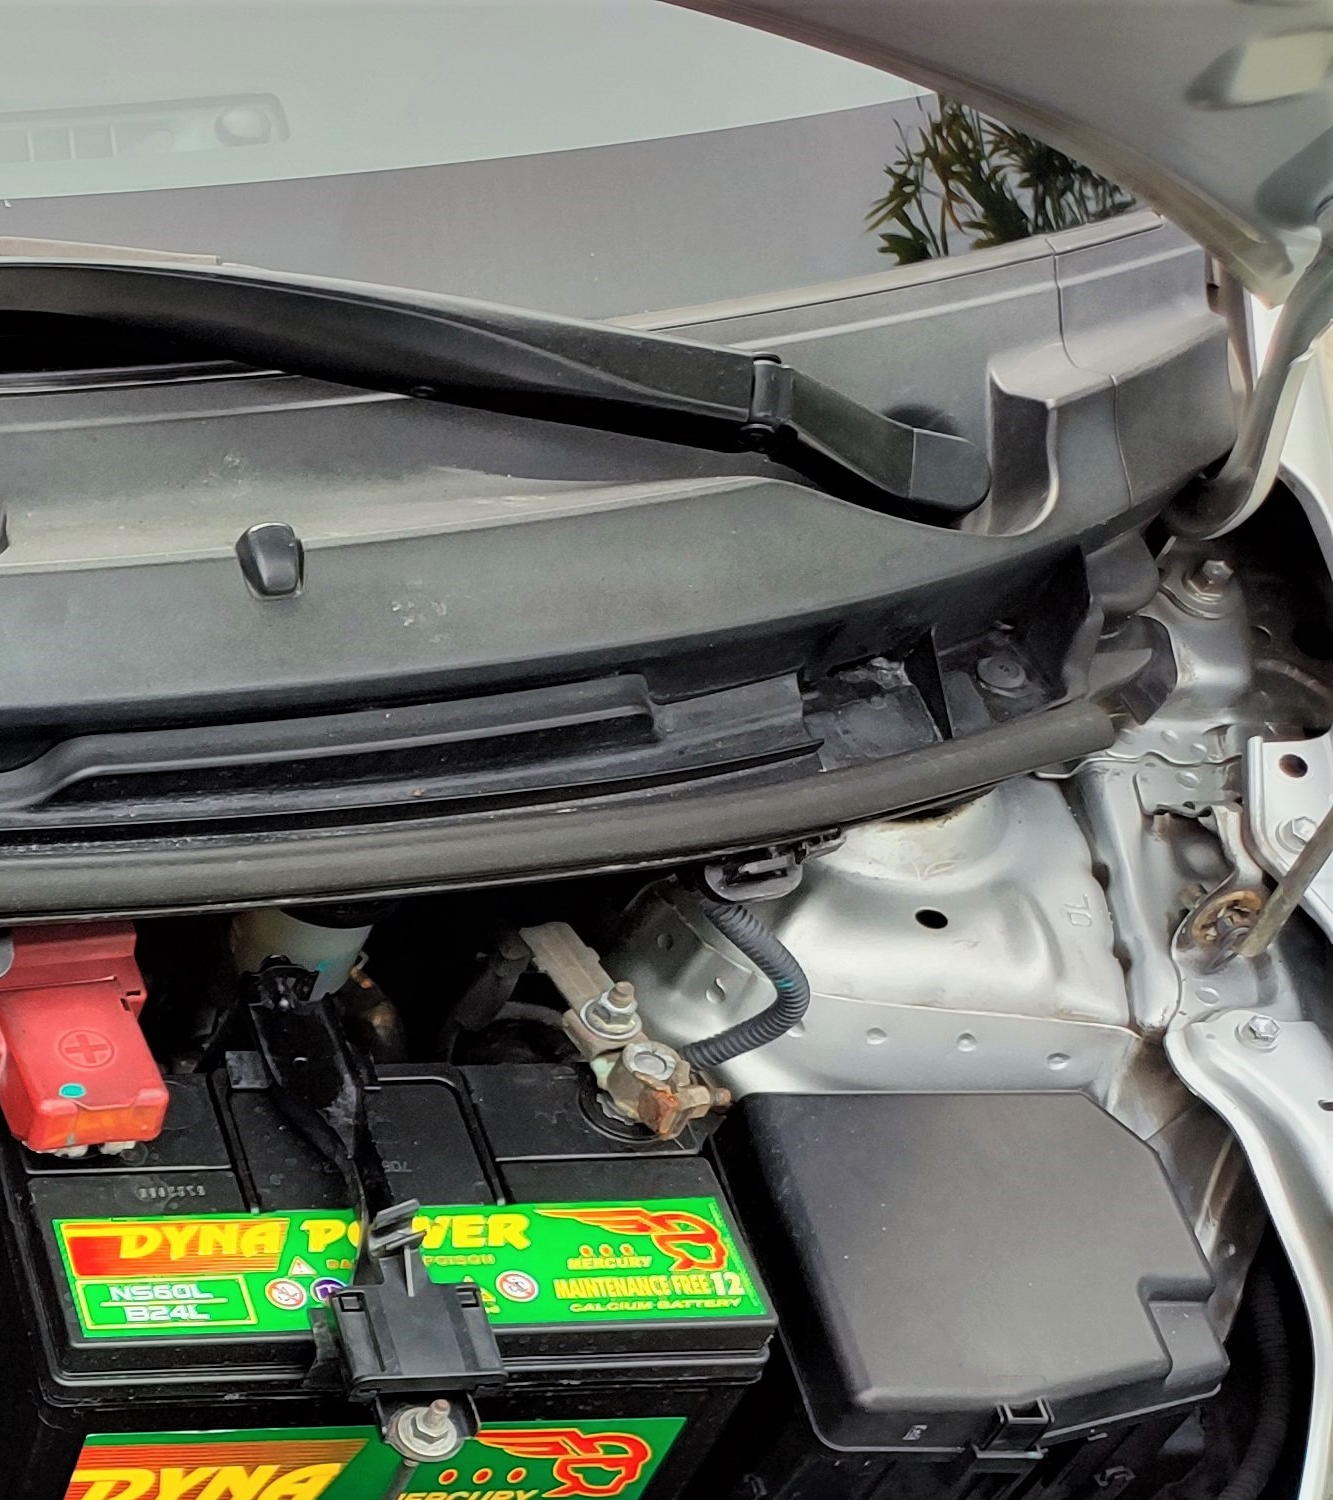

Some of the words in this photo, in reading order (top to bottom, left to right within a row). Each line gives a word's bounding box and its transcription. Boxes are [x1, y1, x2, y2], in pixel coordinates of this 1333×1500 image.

[113, 1222, 282, 1260] DYNA
[300, 1213, 532, 1253] PWER
[567, 1255, 653, 1270] MERCURY
[553, 1275, 669, 1299] MAINTENANCE
[671, 1273, 713, 1296] FREE
[710, 1271, 746, 1296] 12
[569, 1299, 652, 1313] CALCIUM
[656, 1296, 742, 1311] BATTERY
[124, 1305, 212, 1323] B24L
